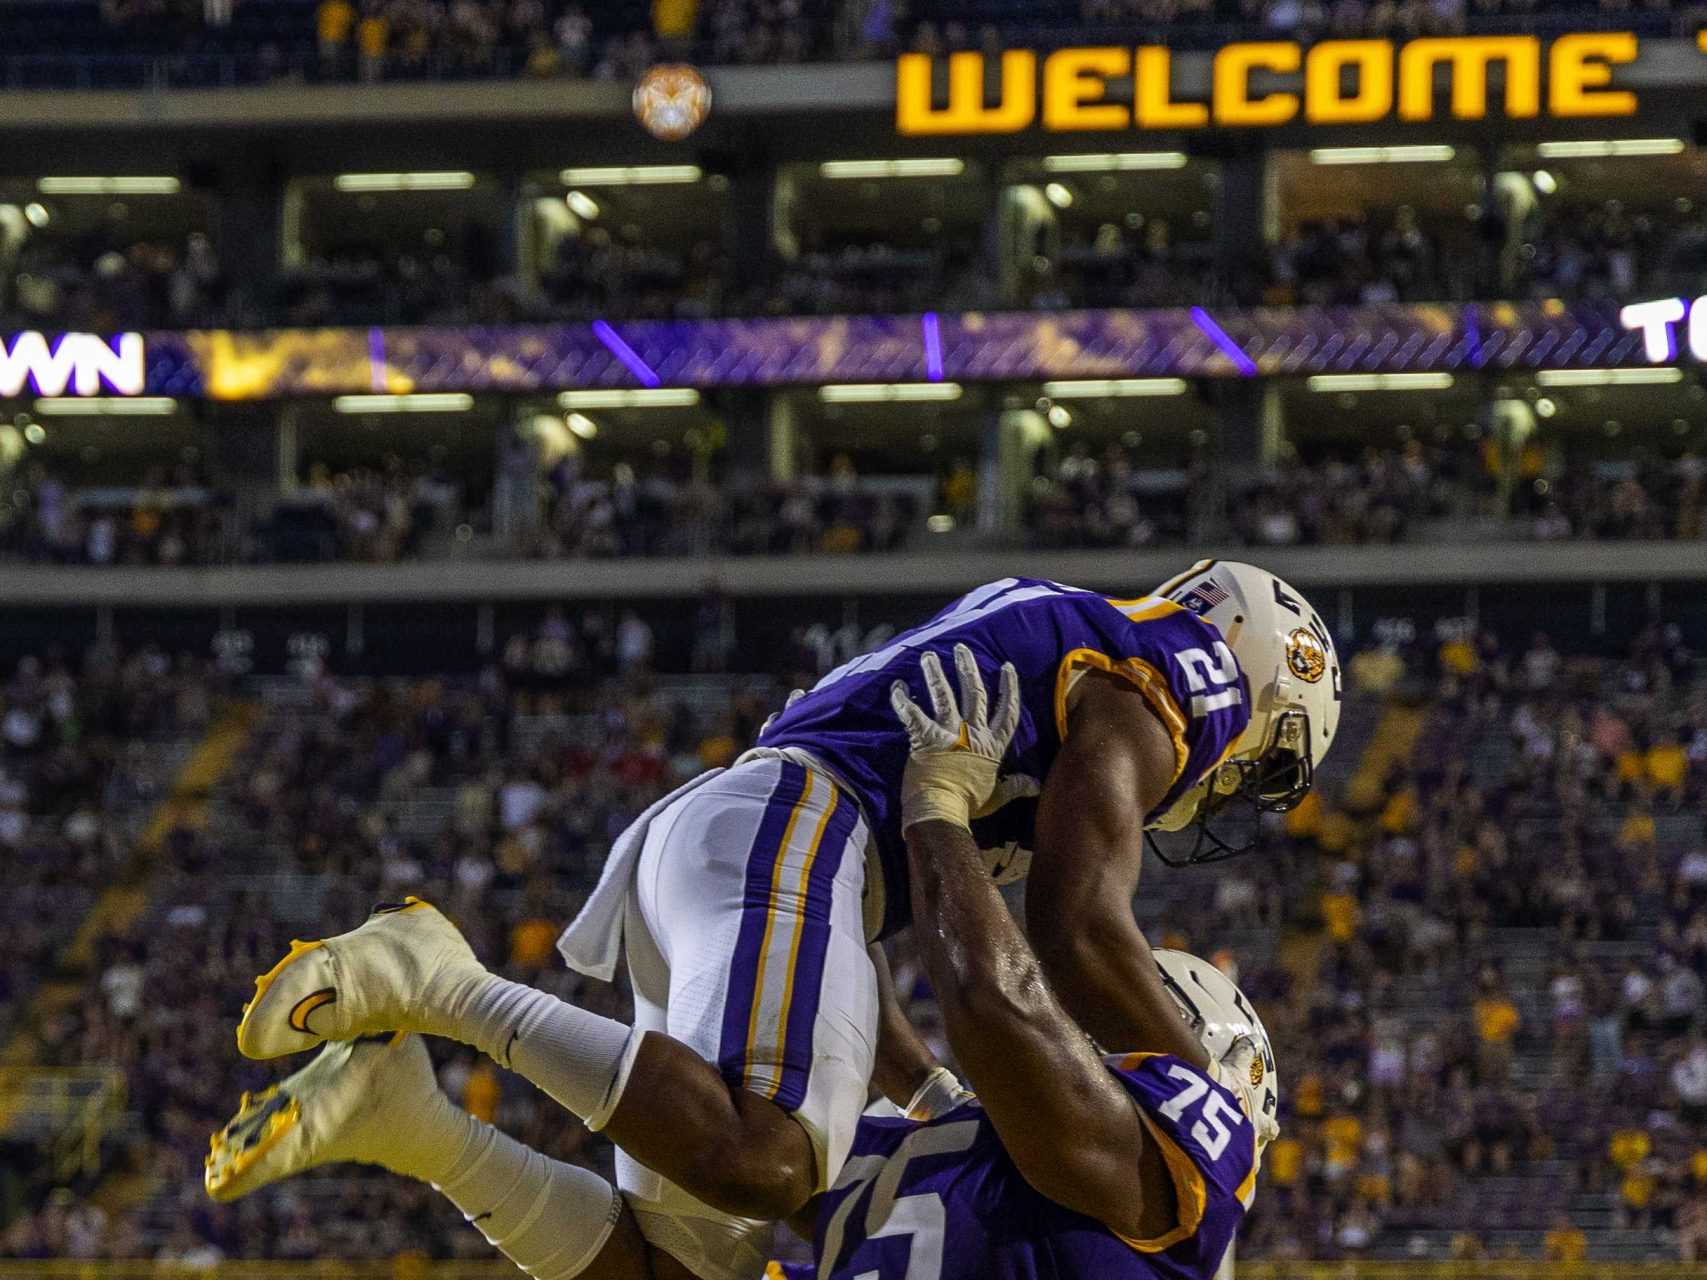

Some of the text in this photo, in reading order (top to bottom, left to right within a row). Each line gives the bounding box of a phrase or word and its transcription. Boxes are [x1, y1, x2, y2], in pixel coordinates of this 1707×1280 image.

[896, 31, 1639, 135] WELCOME
[1174, 640, 1242, 718] 21
[1159, 1063, 1244, 1161] 75
